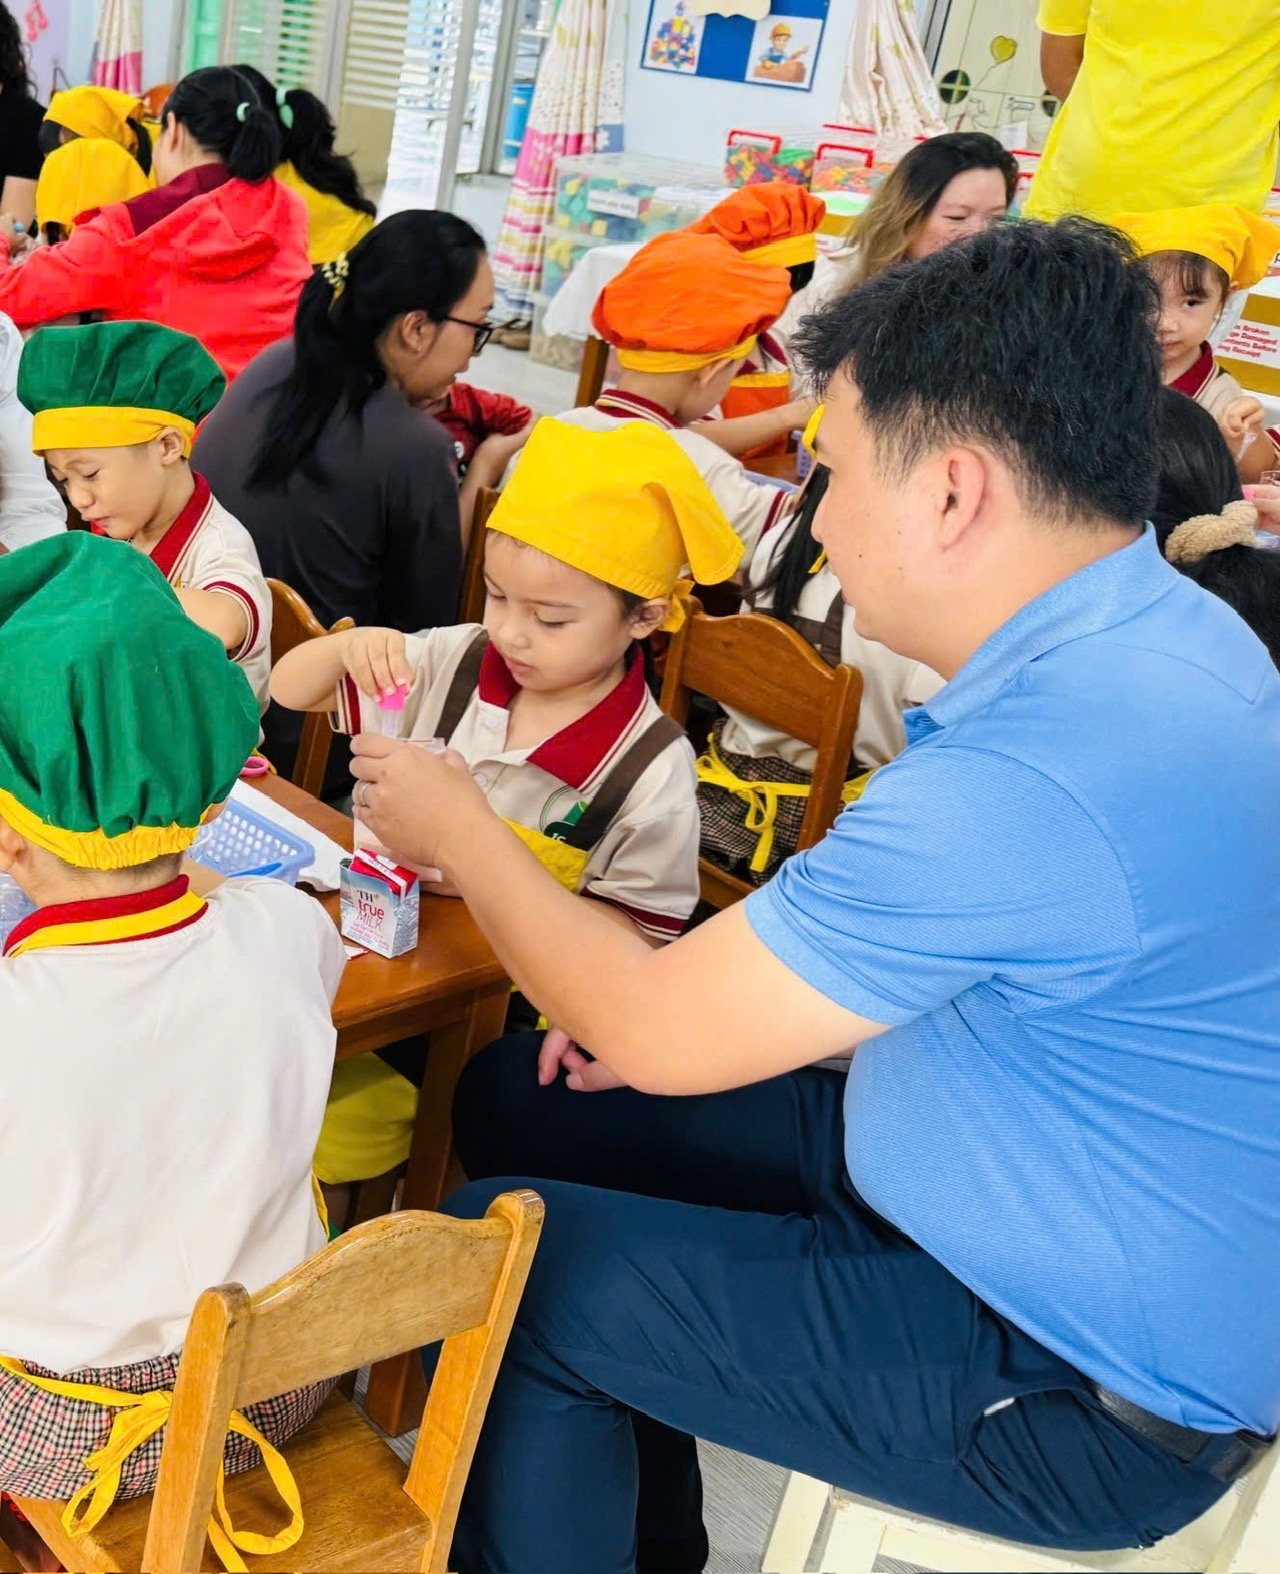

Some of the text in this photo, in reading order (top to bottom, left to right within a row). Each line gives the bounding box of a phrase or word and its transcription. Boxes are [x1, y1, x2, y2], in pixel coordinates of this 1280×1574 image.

[1241, 332, 1278, 345] Damaged
[357, 889, 373, 902] TH
[358, 899, 385, 920] true
[356, 909, 383, 931] MILK
